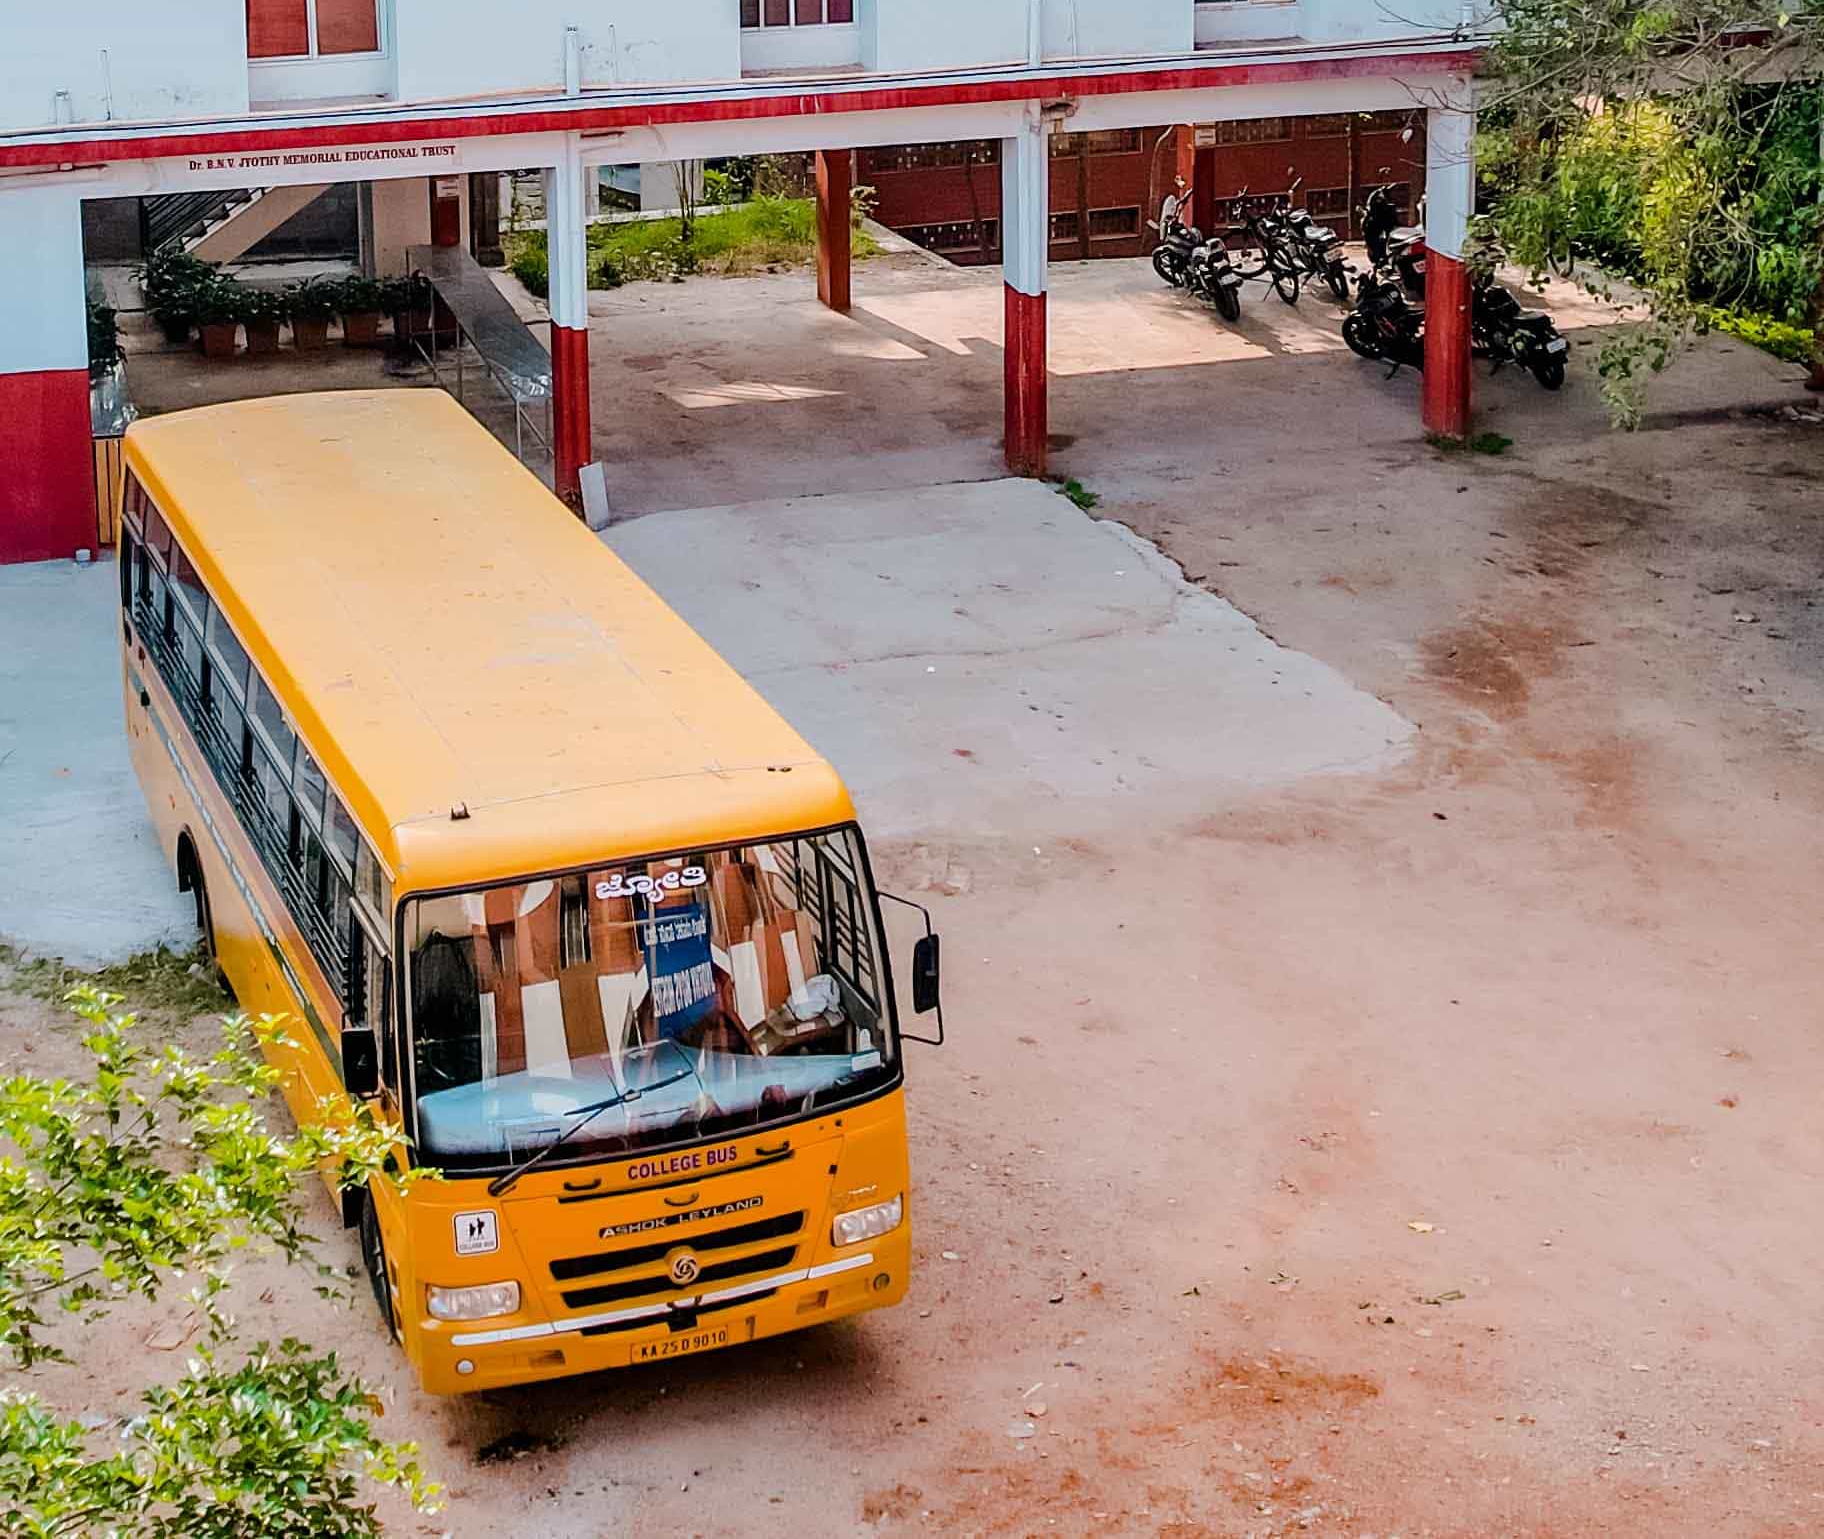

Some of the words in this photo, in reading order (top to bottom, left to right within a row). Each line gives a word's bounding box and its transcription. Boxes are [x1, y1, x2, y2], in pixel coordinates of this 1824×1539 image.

[189, 160, 204, 171] Dr.
[239, 155, 281, 168] JYOTHY
[283, 152, 342, 165] MEMORIAL
[345, 148, 418, 162] EDUCATIONAL
[422, 145, 456, 157] TRUST
[595, 866, 707, 903] ಜ್ಯೋತಿ
[627, 1153, 702, 1180] COLLEGE
[707, 1145, 738, 1165] BUS
[601, 1218, 668, 1238] ASHOK
[679, 1196, 762, 1223] LEYLAND
